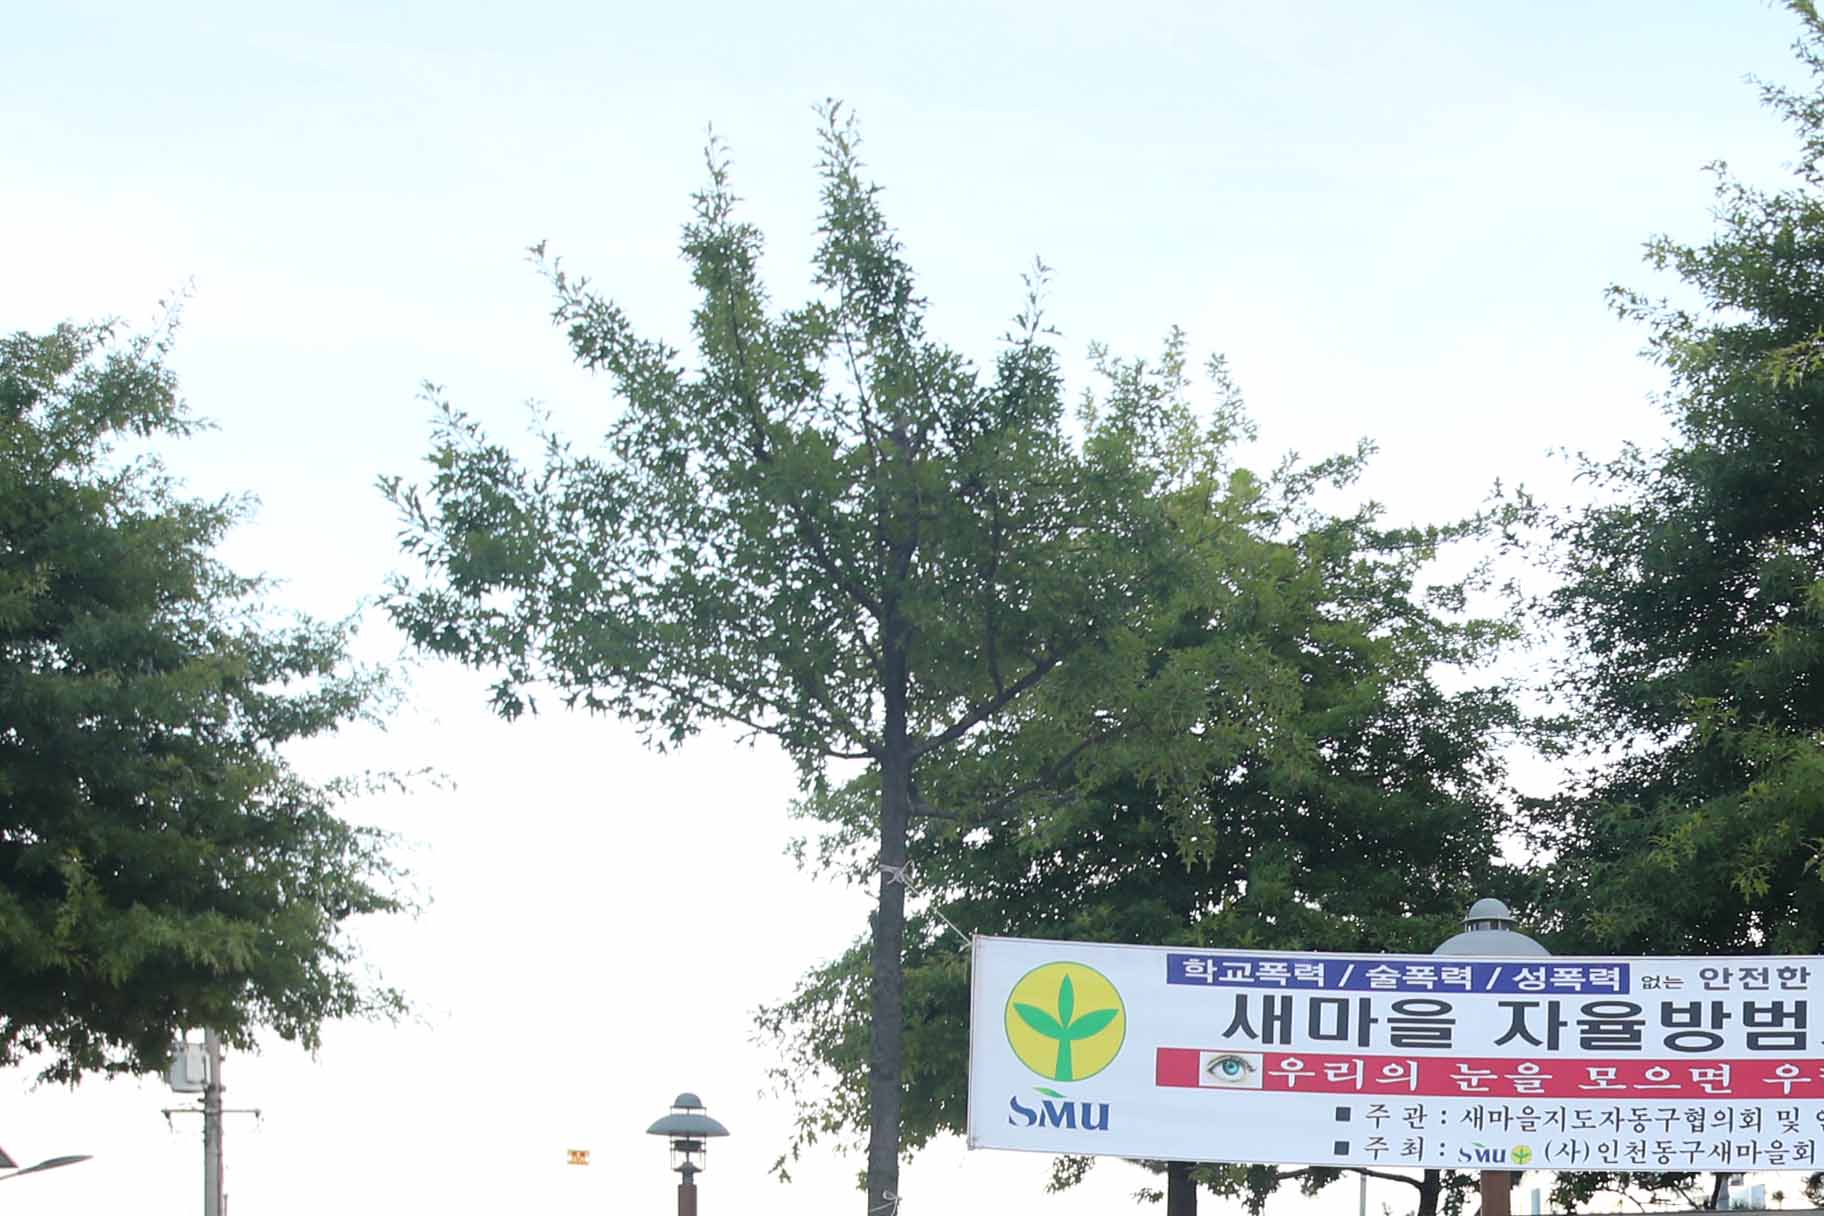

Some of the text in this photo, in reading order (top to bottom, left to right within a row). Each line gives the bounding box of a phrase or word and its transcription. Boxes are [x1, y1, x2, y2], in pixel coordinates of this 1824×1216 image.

[1183, 958, 1325, 987] 학교폭력
[1366, 965, 1471, 990] 술폭력
[1513, 967, 1619, 991] 성폭력
[1642, 976, 1683, 989] 없는
[1700, 967, 1810, 990] 안전한
[1222, 993, 1456, 1048] 새마을
[1268, 1057, 1418, 1092] 우리의
[1451, 1063, 1552, 1093] 눈을
[1579, 1064, 1731, 1093] 모으면
[1009, 1094, 1109, 1130] SMU
[1462, 1105, 1761, 1133] 새마을지도자동구협의회
[1778, 1107, 1798, 1132] 및
